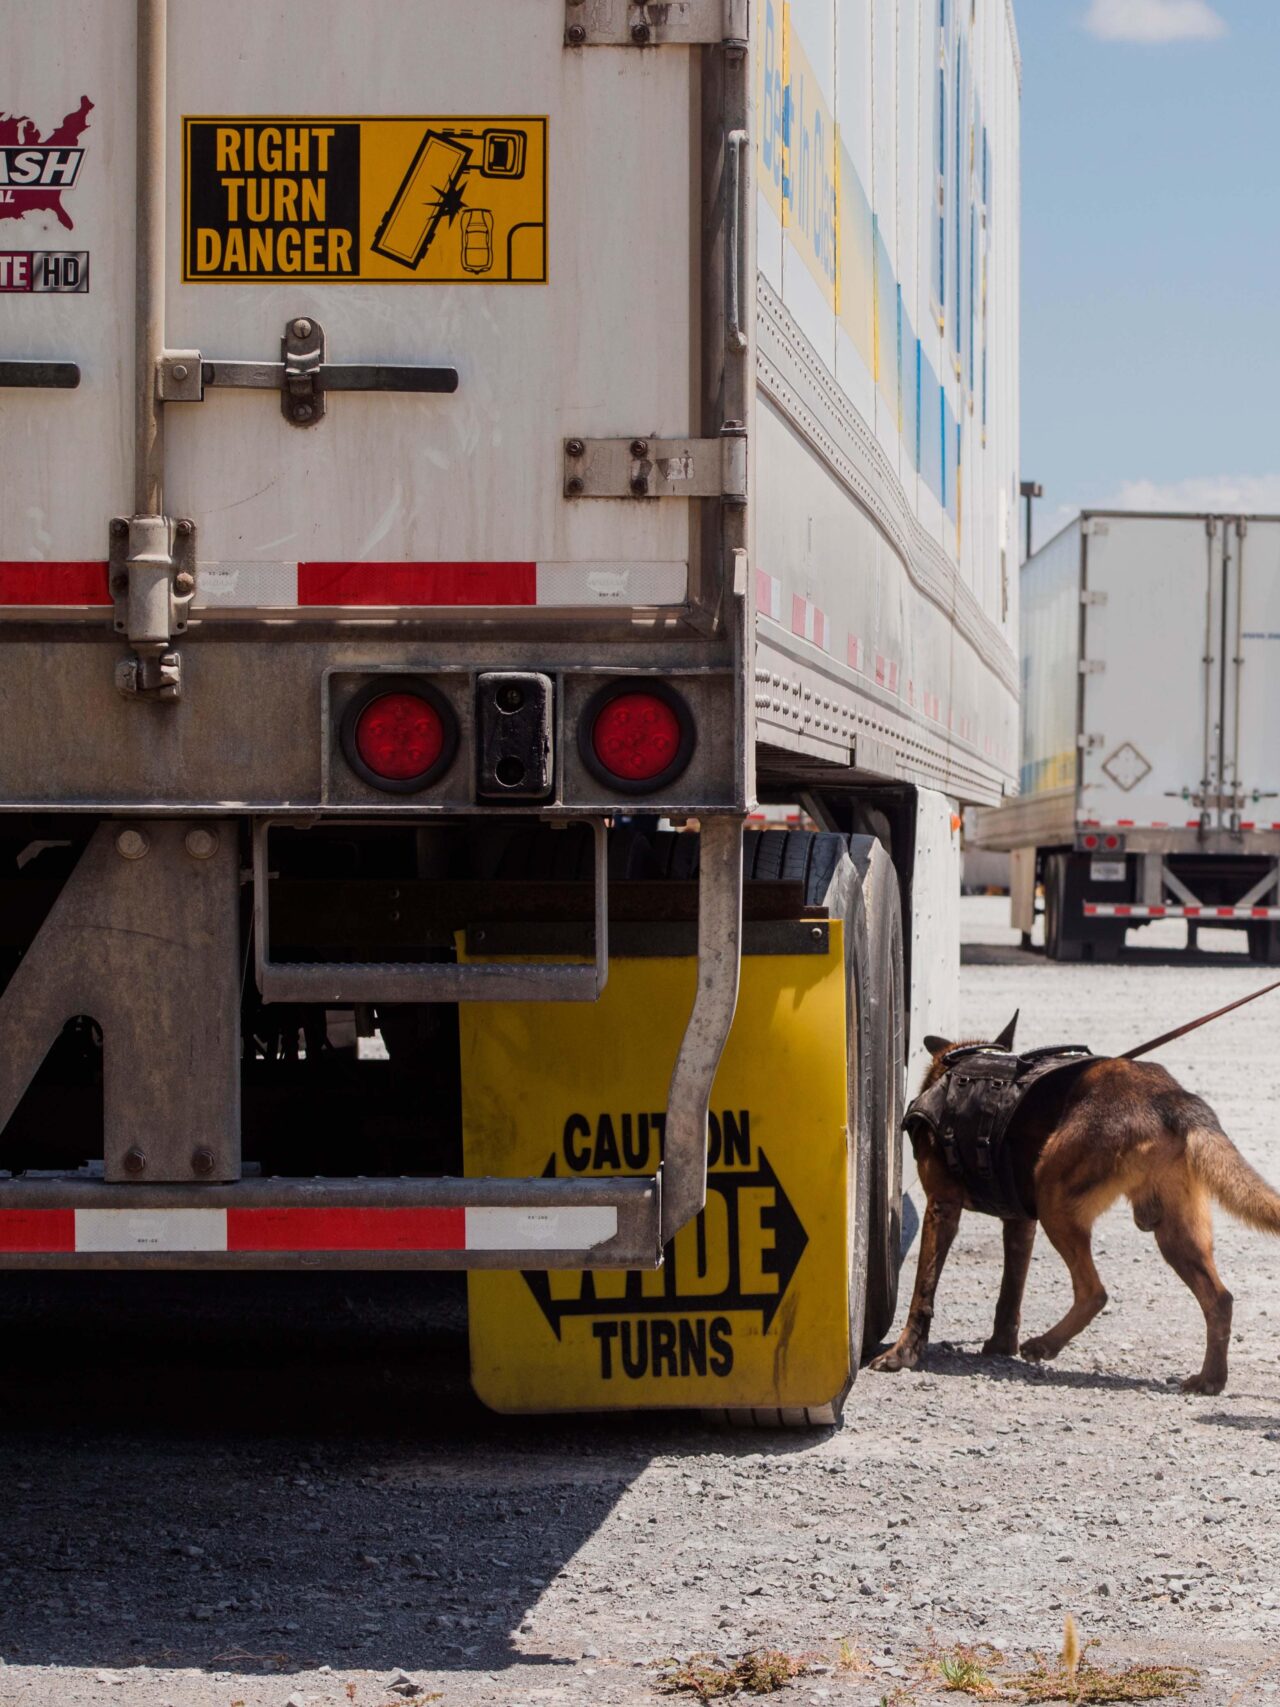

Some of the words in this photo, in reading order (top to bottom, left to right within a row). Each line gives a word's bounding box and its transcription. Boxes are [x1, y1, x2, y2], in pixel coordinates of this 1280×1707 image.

[0, 151, 82, 184] SH
[216, 127, 336, 173] RIGHT
[221, 178, 326, 222] TURN
[42, 256, 80, 288] HD
[197, 227, 353, 273] DANGER
[563, 1110, 751, 1172] CAUTON
[546, 1186, 780, 1301] DE
[592, 1316, 735, 1381] TURNS
